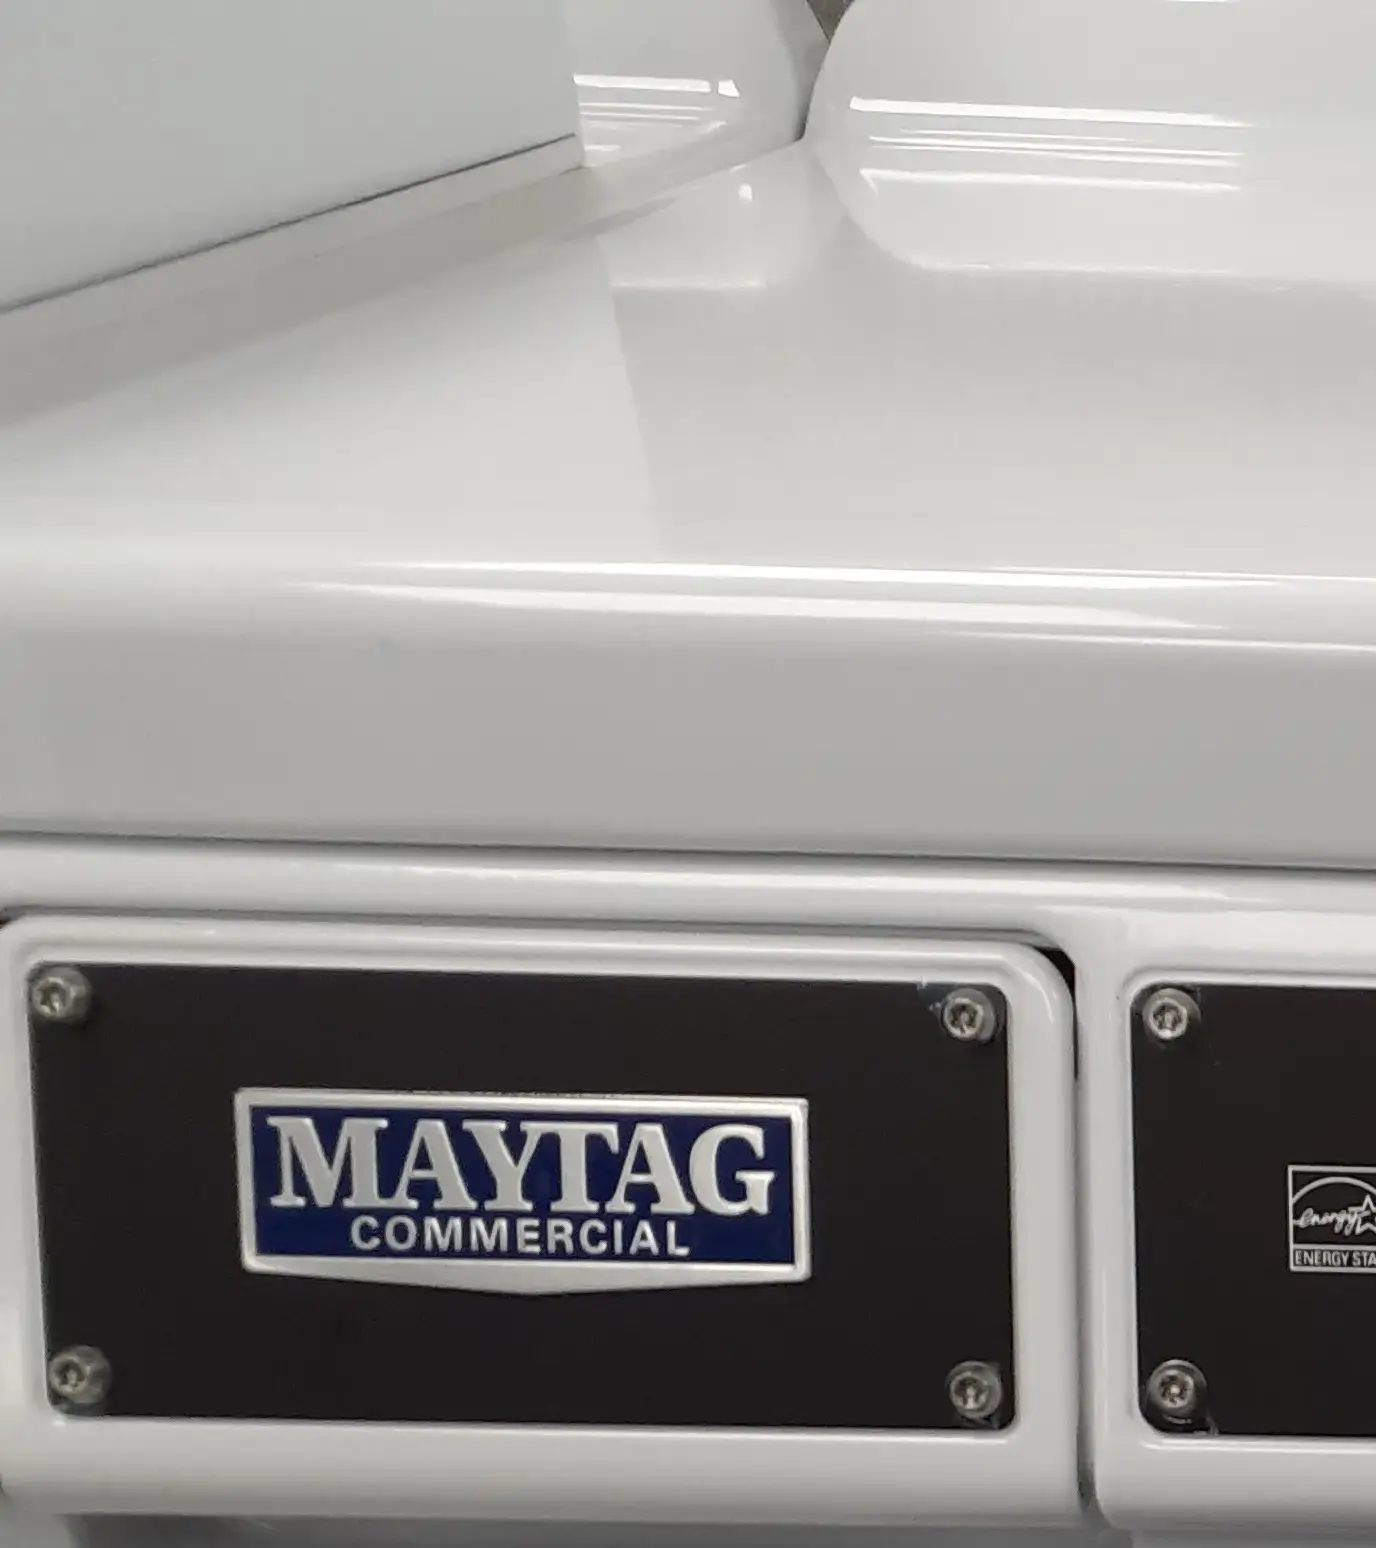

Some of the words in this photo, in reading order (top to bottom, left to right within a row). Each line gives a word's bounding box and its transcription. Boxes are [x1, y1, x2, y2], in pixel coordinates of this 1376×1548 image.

[267, 1115, 775, 1217] MAYTAG
[350, 1213, 691, 1257] COMMERCIAL
[1295, 1250, 1349, 1267] ENERGY
